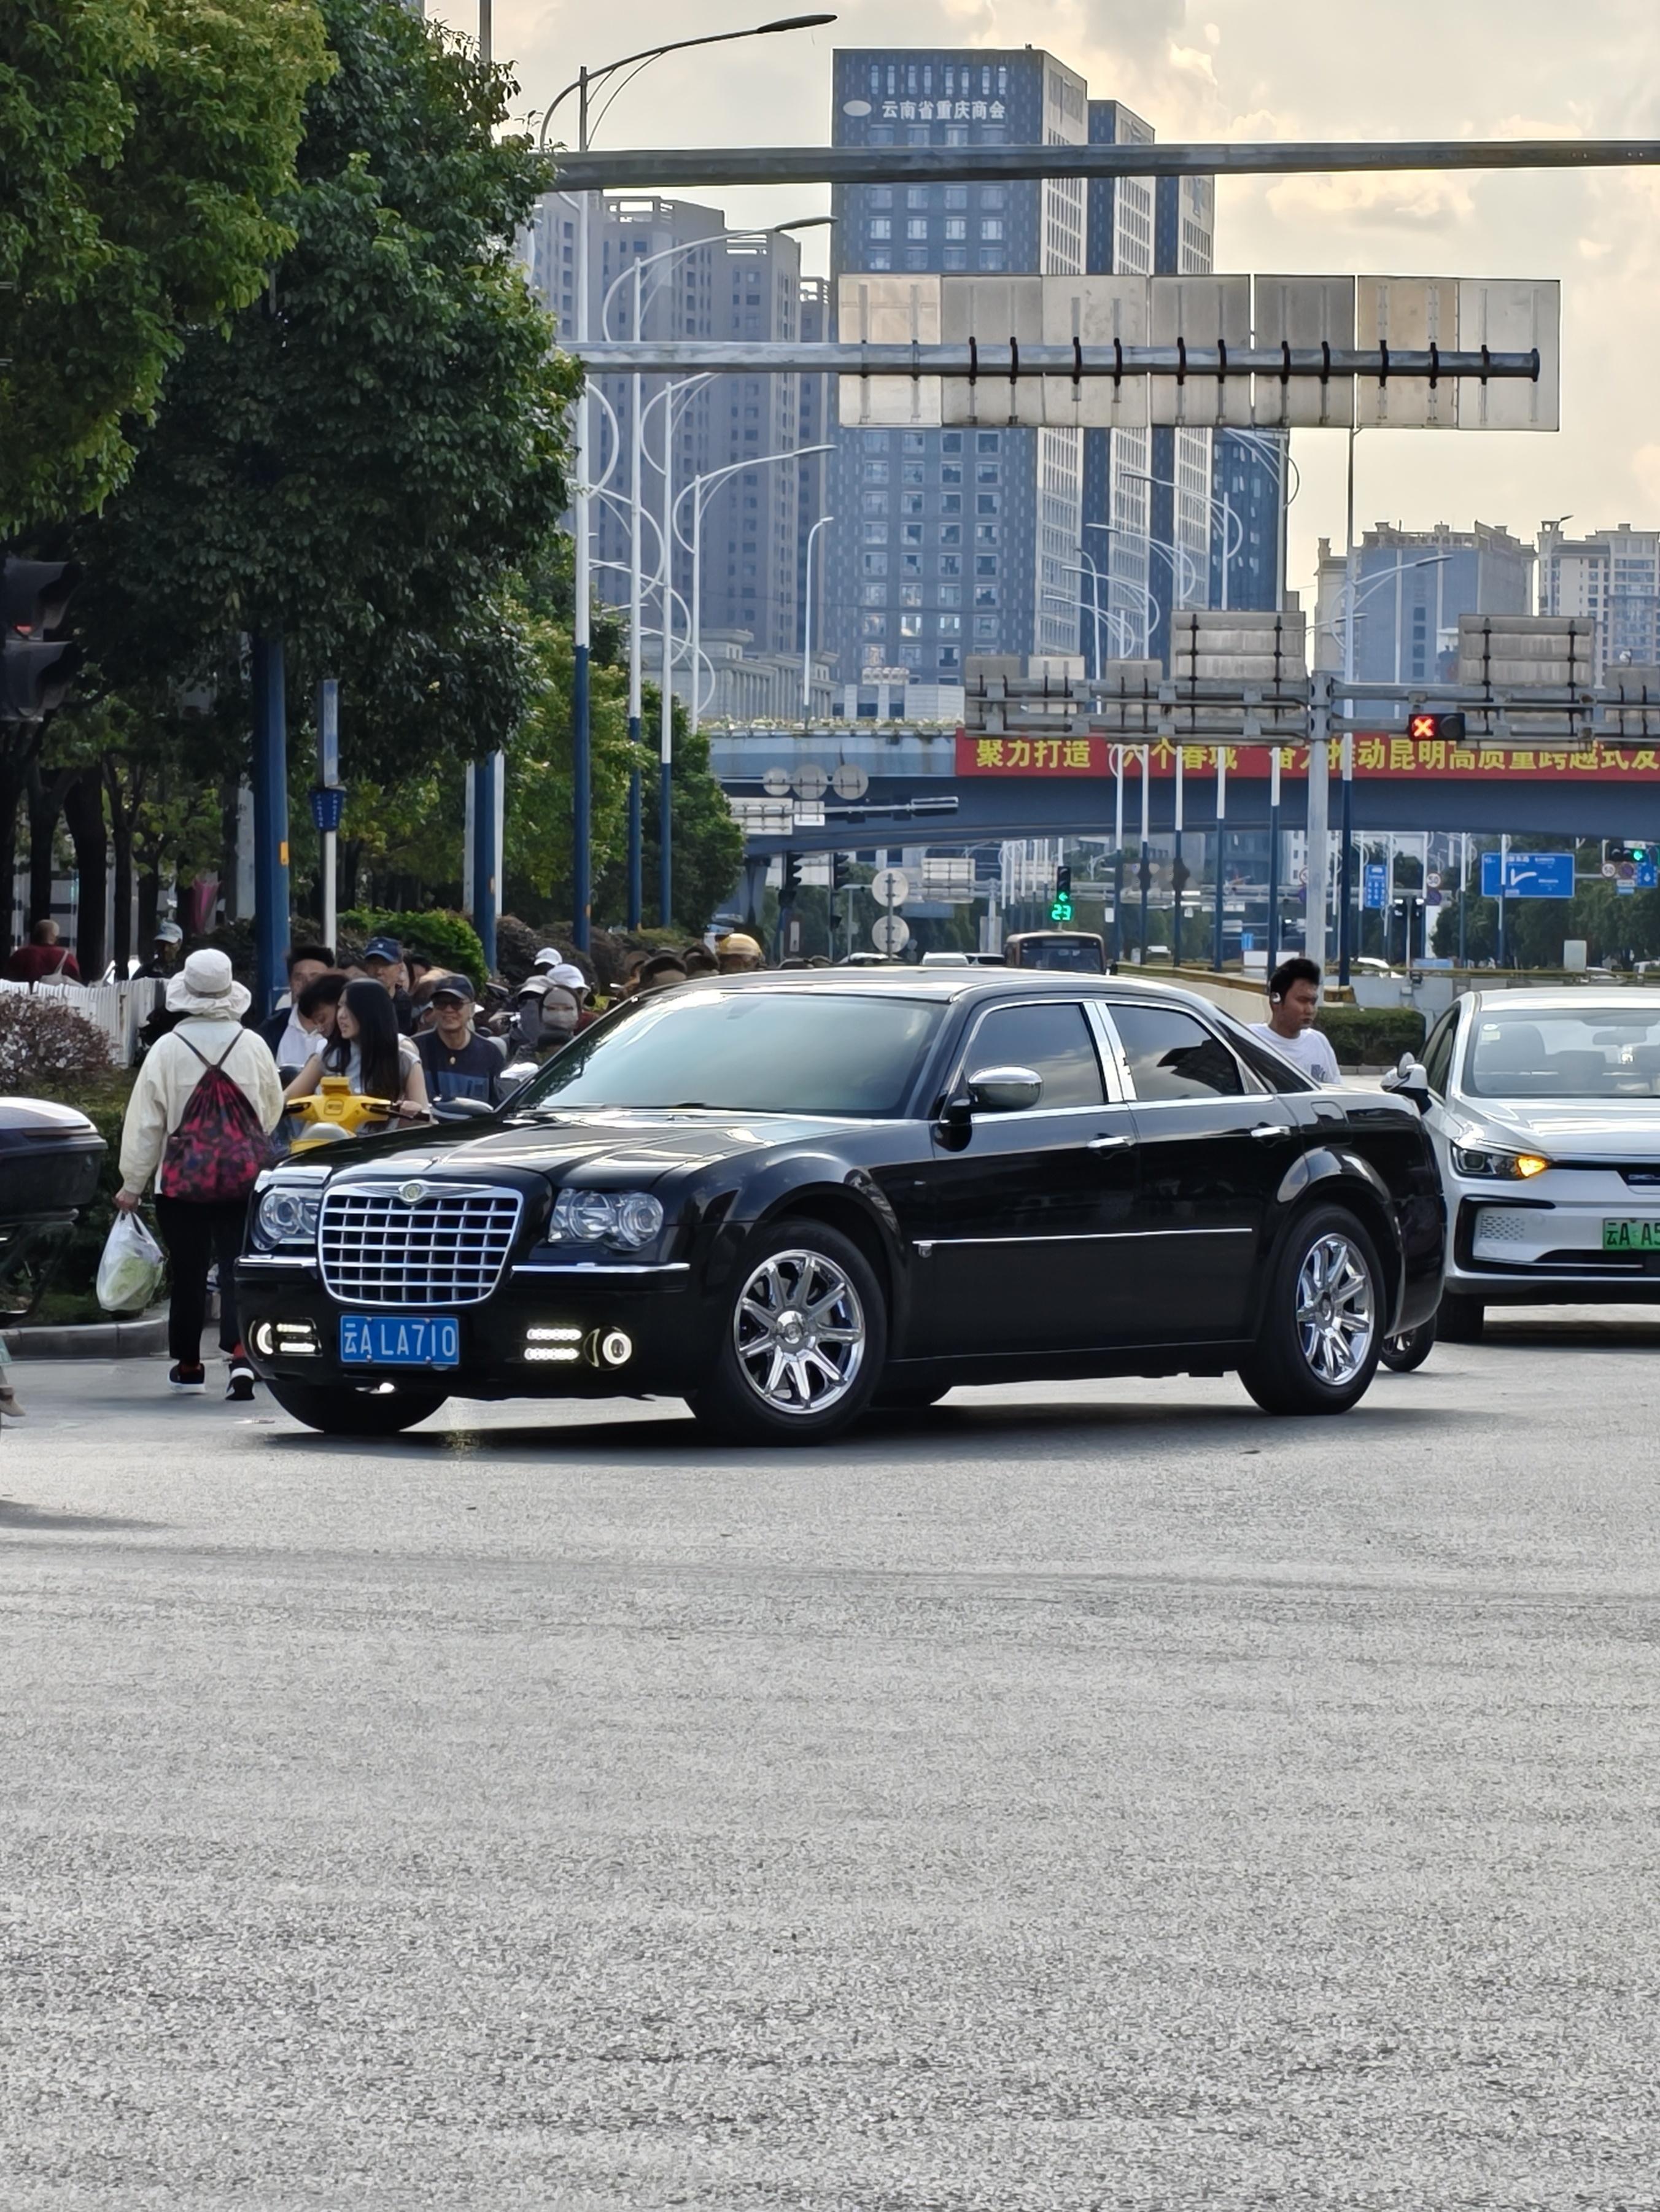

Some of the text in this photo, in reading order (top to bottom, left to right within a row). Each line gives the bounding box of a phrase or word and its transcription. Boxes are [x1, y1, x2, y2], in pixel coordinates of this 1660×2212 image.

[882, 100, 1006, 120] 云南省重庆商会
[1052, 903, 1071, 920] 23
